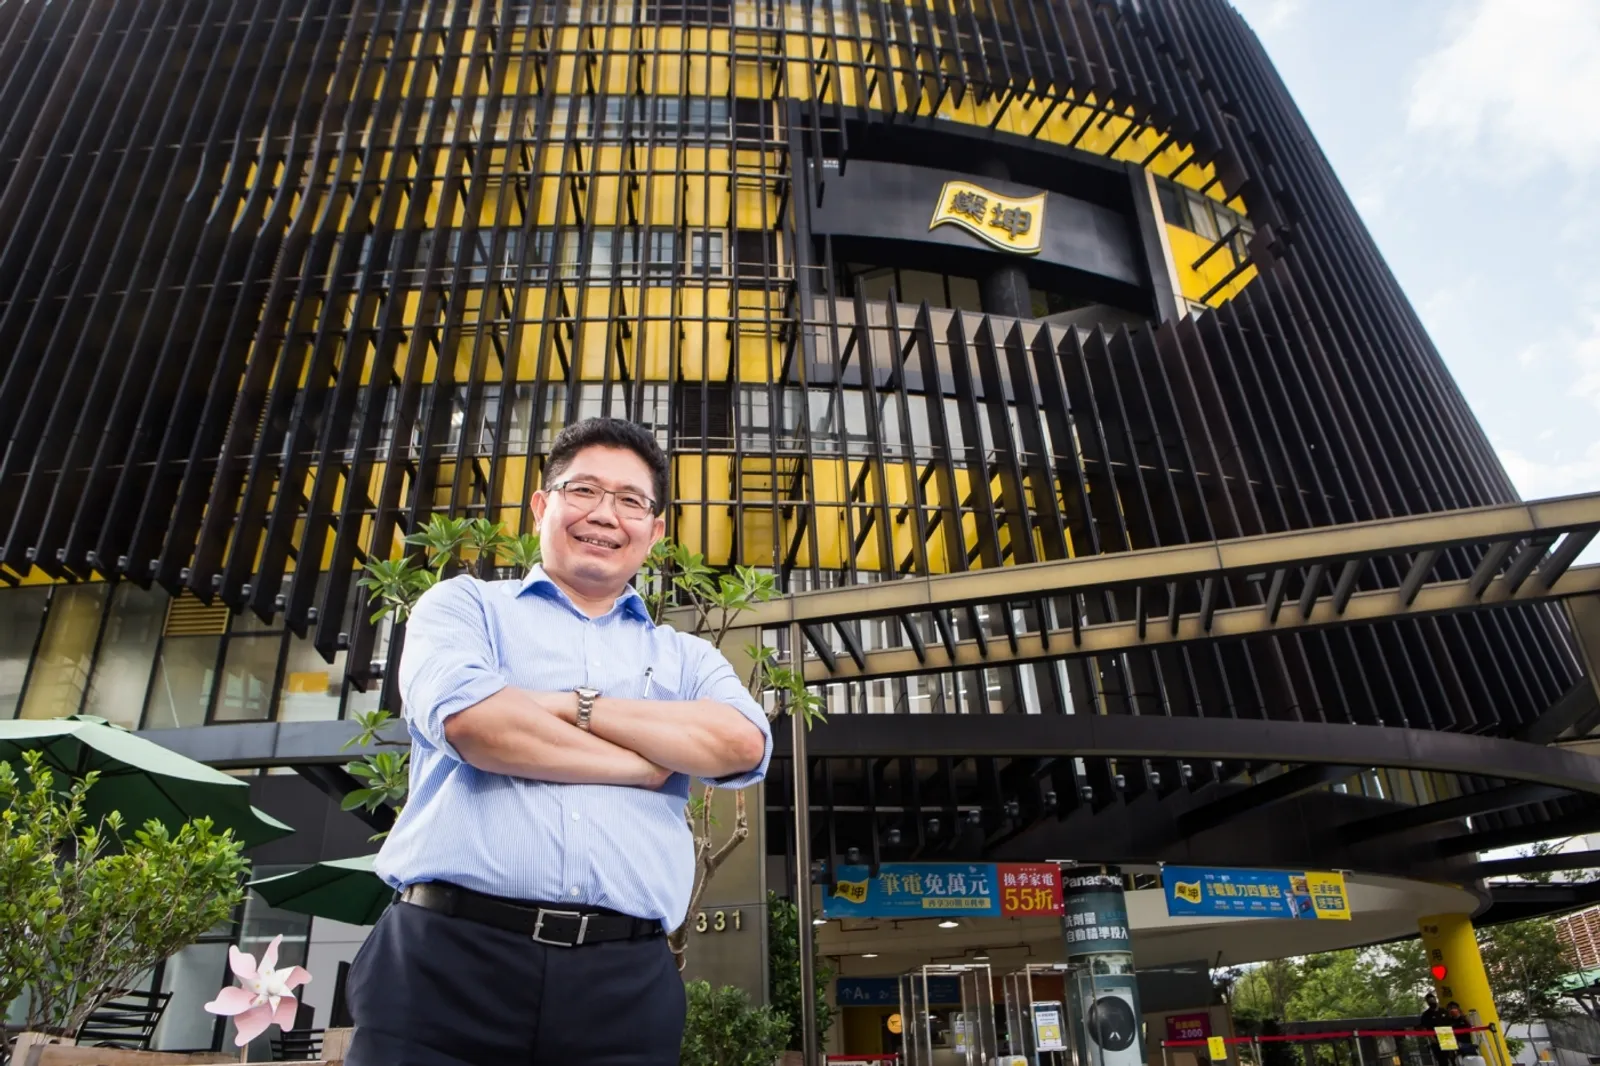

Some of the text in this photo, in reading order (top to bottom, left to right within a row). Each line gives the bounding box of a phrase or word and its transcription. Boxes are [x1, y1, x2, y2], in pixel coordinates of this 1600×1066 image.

[949, 190, 1032, 240] 燦坤
[879, 872, 990, 896] 筆電免萬元
[1003, 872, 1055, 887] 換季家電
[696, 909, 741, 932] 331
